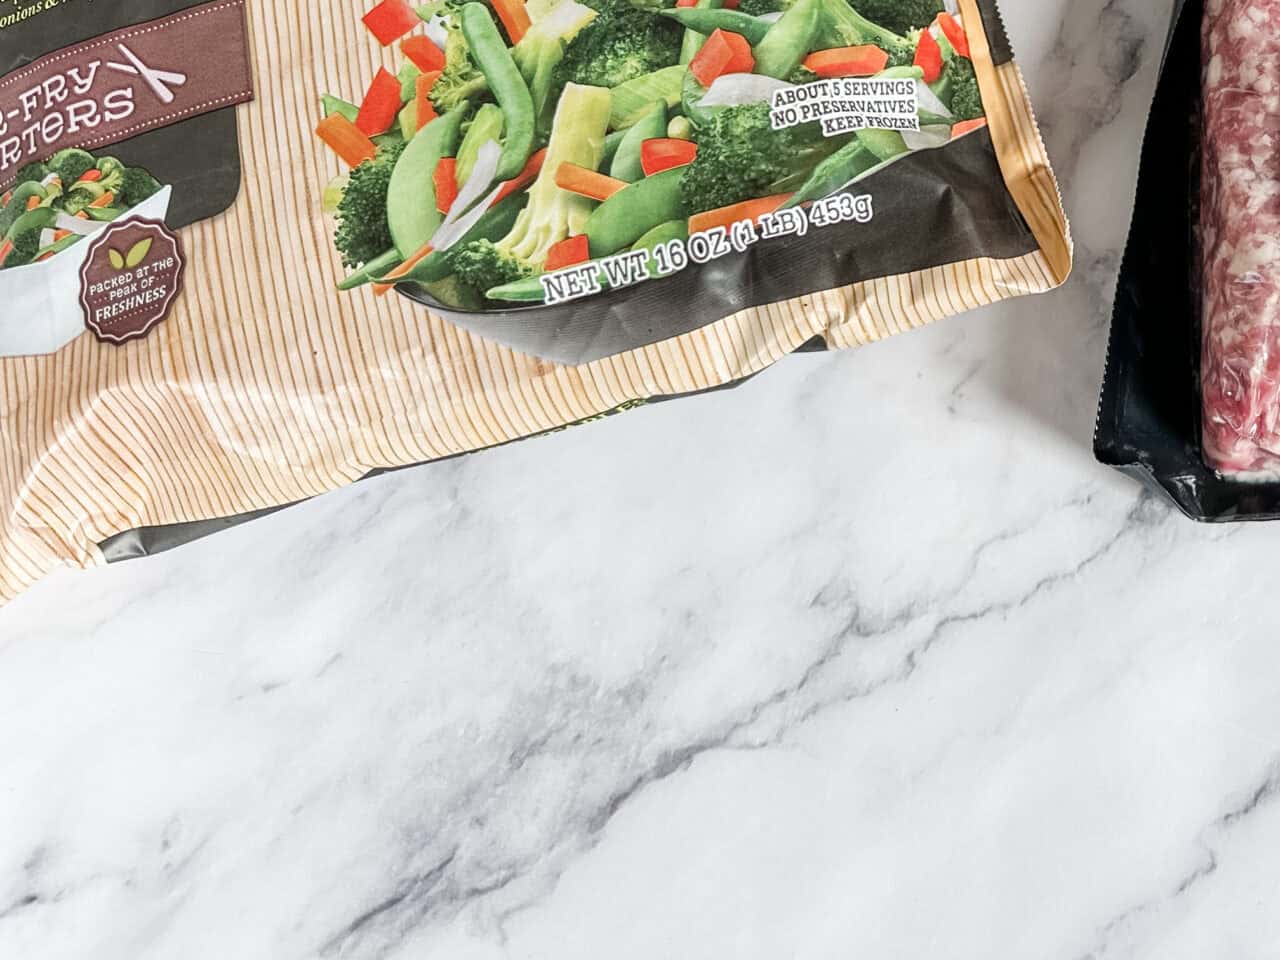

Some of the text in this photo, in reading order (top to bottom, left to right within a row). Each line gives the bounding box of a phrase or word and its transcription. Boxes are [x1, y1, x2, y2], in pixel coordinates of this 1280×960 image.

[774, 80, 914, 107] ABOUT 5 SERVINGS
[772, 99, 916, 128] NO PRESERVATIVES
[823, 115, 918, 133] KEEP FROZEN
[544, 264, 599, 304] NET
[604, 250, 648, 287] WT
[654, 241, 686, 272] 16
[688, 231, 729, 263] OZ
[810, 194, 873, 228] 453g
[140, 276, 155, 289] OF
[95, 285, 167, 323] FRESHNESS
